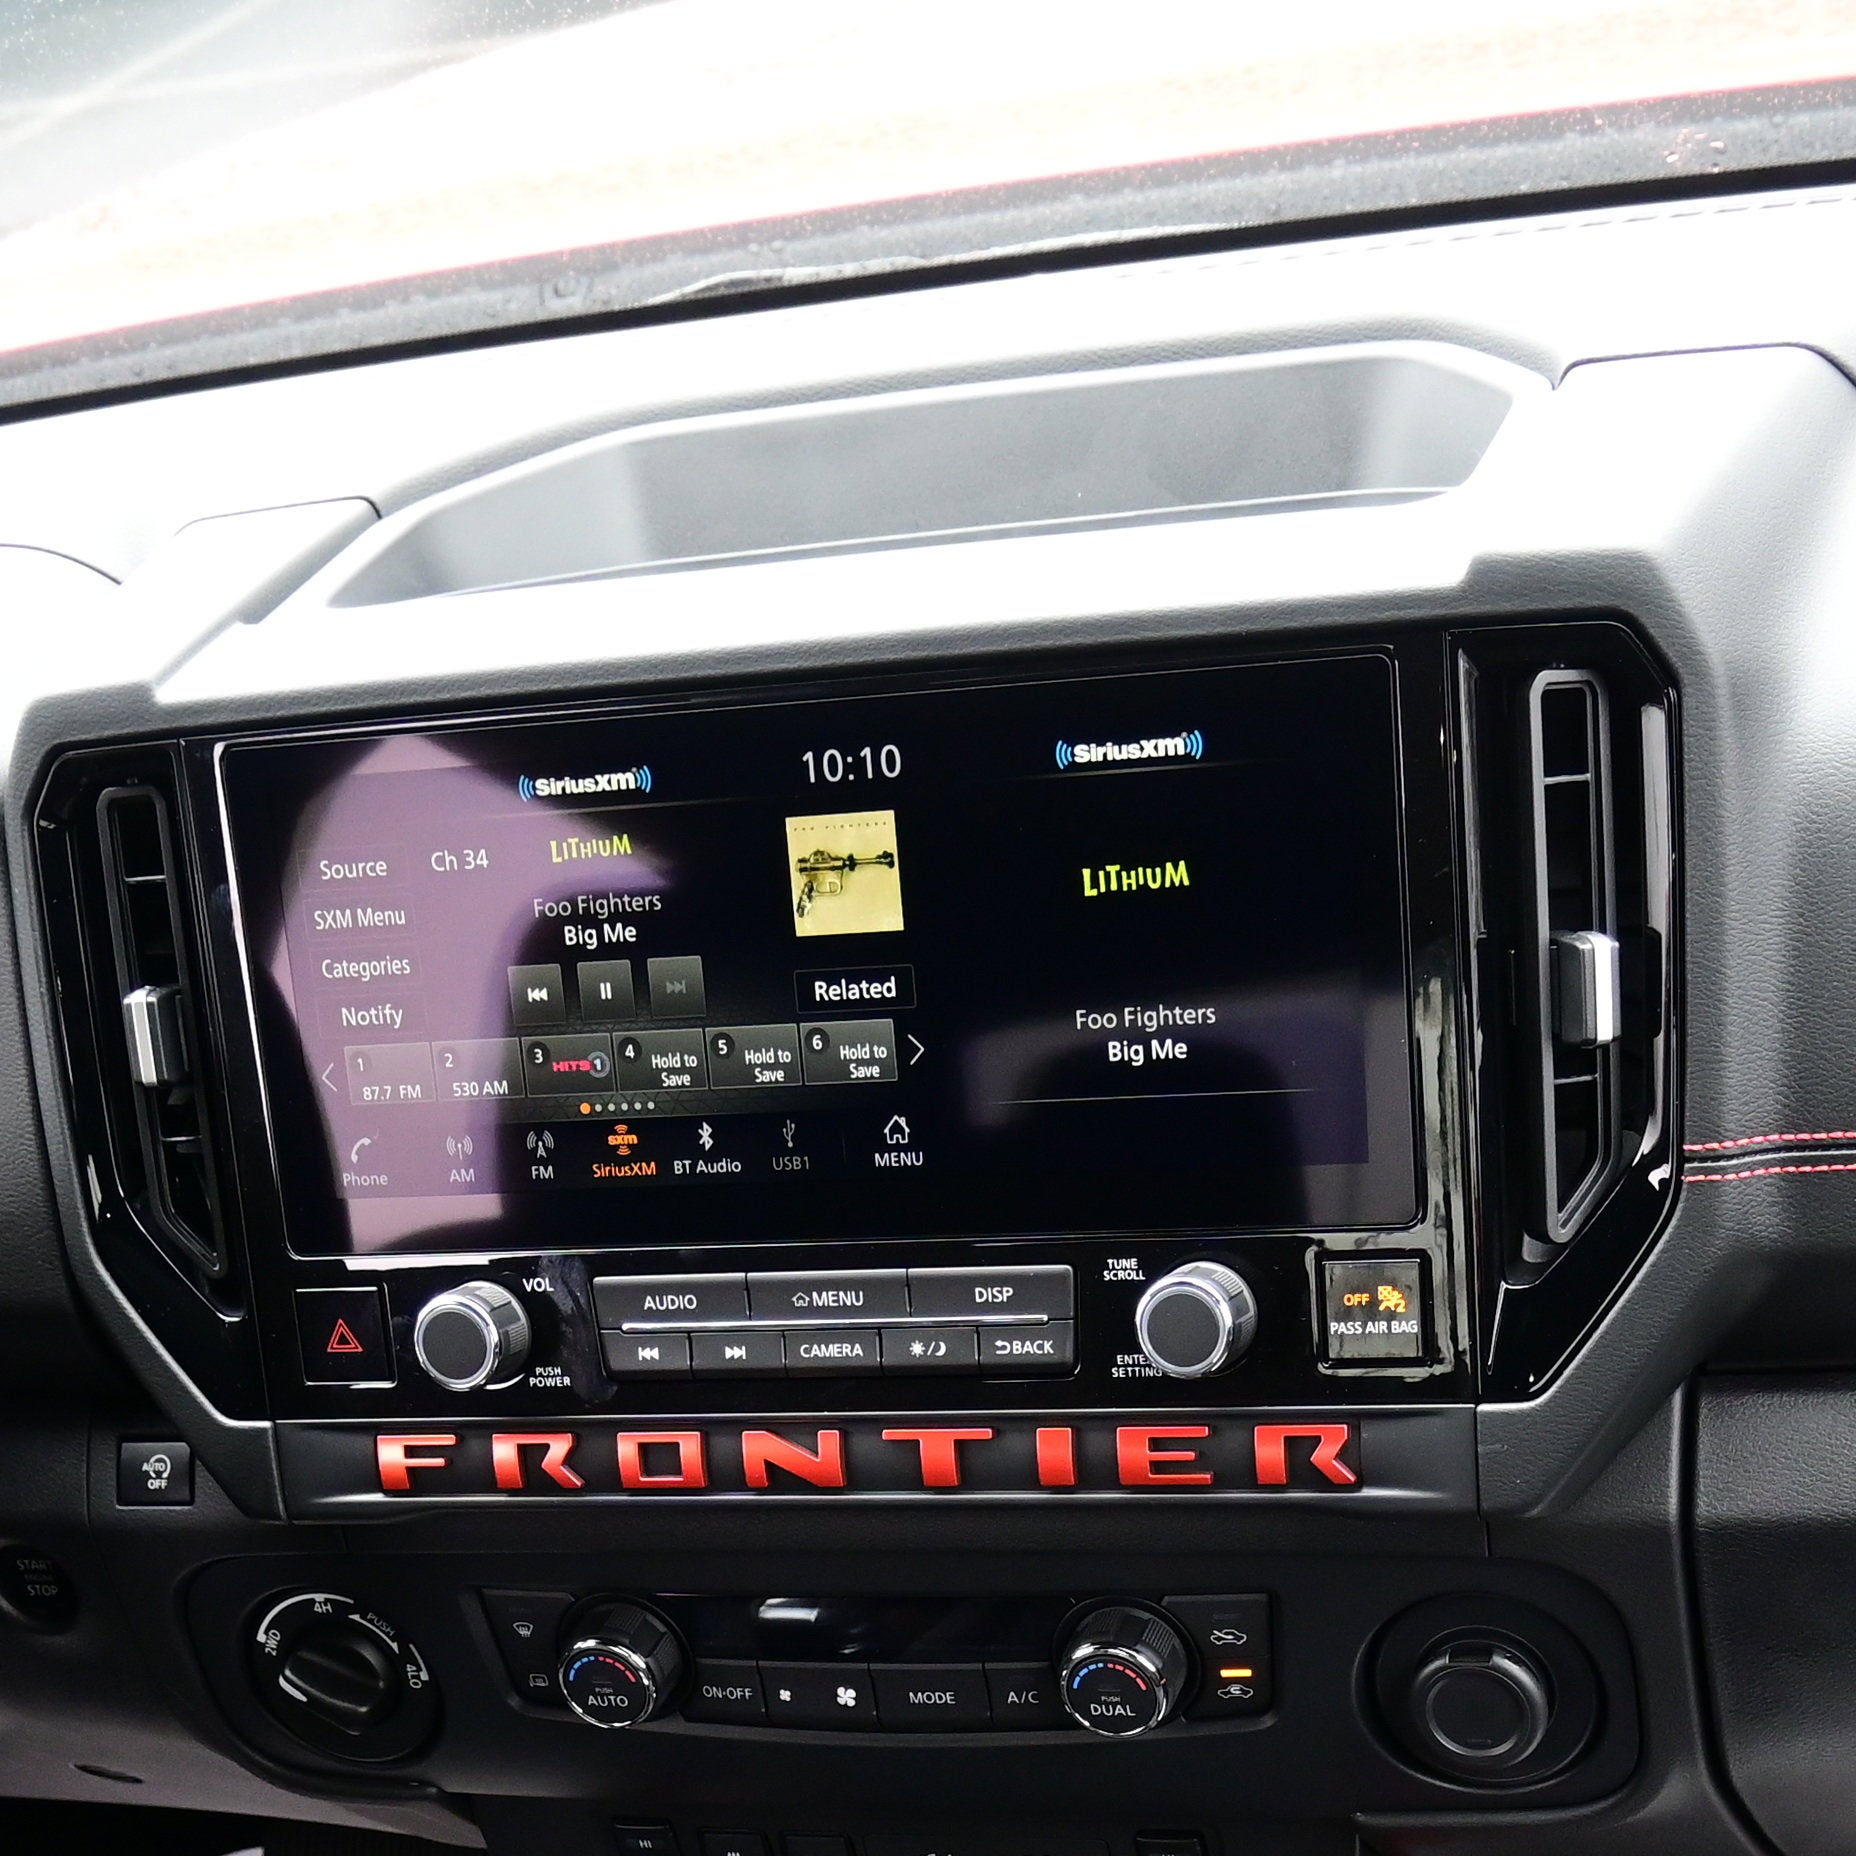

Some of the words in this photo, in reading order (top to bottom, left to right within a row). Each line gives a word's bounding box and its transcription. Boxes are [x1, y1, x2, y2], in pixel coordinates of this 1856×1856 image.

[802, 744, 901, 784] 10:10
[431, 851, 458, 871] Ch
[463, 849, 488, 870] 34
[320, 860, 387, 880] Source
[534, 898, 571, 918] Foo
[577, 893, 662, 919] Fighters
[314, 910, 352, 930] SXM
[357, 908, 406, 927] Menu
[564, 925, 597, 949] Big
[604, 923, 637, 943] Me
[322, 956, 410, 981] Categories
[814, 976, 896, 1001] Related
[342, 1004, 403, 1028] Notify
[1075, 1009, 1117, 1030] Foo
[1124, 1005, 1216, 1033] Fighters
[745, 1049, 775, 1065] Hold
[777, 1050, 791, 1063] to
[840, 1044, 870, 1060] Hold
[873, 1045, 887, 1058] to
[1107, 1040, 1144, 1067] Big
[1151, 1038, 1188, 1060] Me
[652, 1053, 682, 1069] Hold
[684, 1054, 697, 1068] to
[755, 1068, 784, 1083] Save
[849, 1064, 880, 1078] Save
[662, 1072, 690, 1087] Save
[363, 1086, 392, 1100] 87.7
[400, 1085, 421, 1099] FM
[453, 1082, 478, 1096] 530
[483, 1080, 508, 1095] AM
[674, 1160, 692, 1175] BT
[696, 1158, 742, 1174] Audio
[773, 1156, 810, 1170] USB1
[875, 1152, 923, 1168] MENU
[450, 1169, 475, 1182] AM
[532, 1166, 554, 1179] FM
[593, 1162, 656, 1178] SiriusXM
[343, 1173, 388, 1186] Phone
[1107, 1258, 1138, 1270] TUNE
[1103, 1269, 1146, 1281] SCROLL
[522, 1278, 555, 1293] VOL
[643, 1294, 697, 1310] AUDIO
[812, 1291, 863, 1307] MENU
[974, 1286, 1014, 1303] DISP
[1344, 1294, 1370, 1306] OFF
[1330, 1321, 1363, 1335] PASS
[1366, 1321, 1388, 1334] AIR
[1390, 1321, 1418, 1334] BAG
[800, 1342, 863, 1358] CAMERA
[1012, 1340, 1054, 1354] BACK
[535, 1367, 562, 1377] PUSH
[529, 1376, 572, 1388] POWER
[375, 1424, 1363, 1491] FRONTIER
[147, 1479, 168, 1490] OFF
[314, 1602, 333, 1614] 4H
[366, 1612, 396, 1637] PUSH
[265, 1629, 281, 1656] 2WD
[406, 1664, 422, 1689] 4LO
[587, 1694, 628, 1708] AUTO
[909, 1692, 956, 1704] MODE
[1007, 1691, 1039, 1704] A/C
[1090, 1704, 1136, 1716] DUAL
